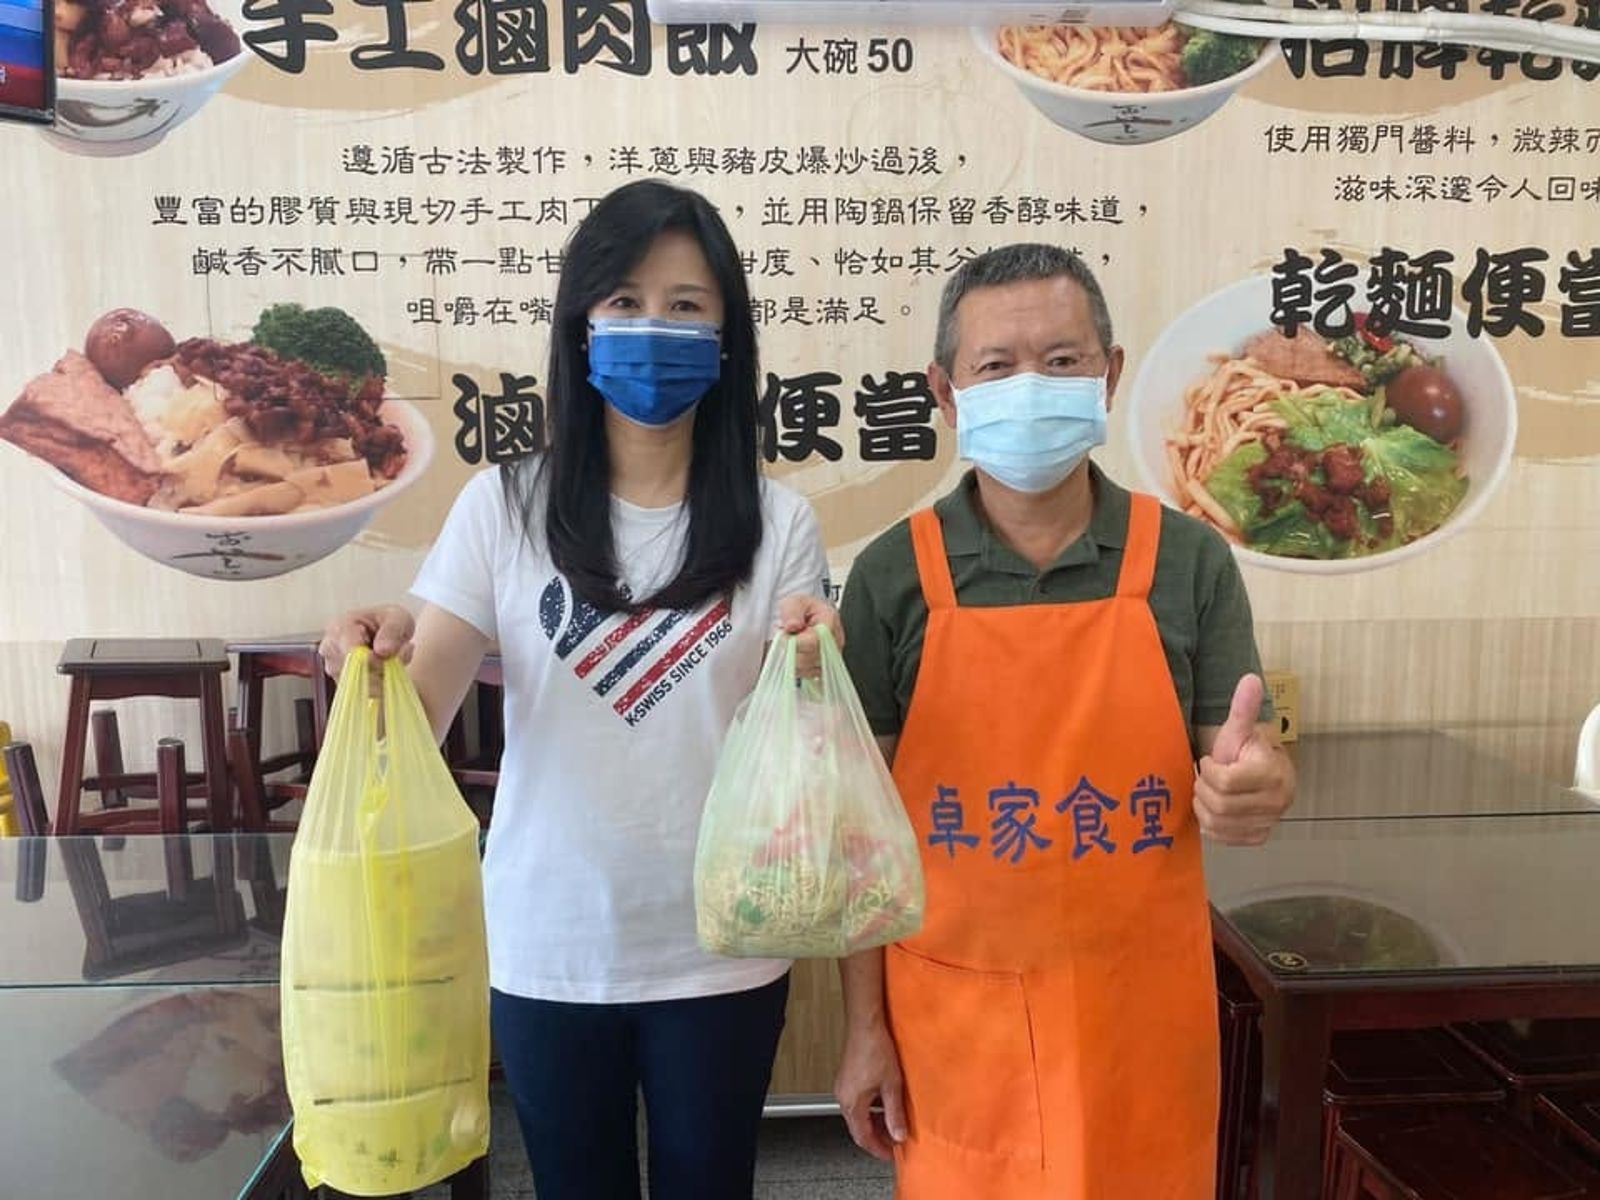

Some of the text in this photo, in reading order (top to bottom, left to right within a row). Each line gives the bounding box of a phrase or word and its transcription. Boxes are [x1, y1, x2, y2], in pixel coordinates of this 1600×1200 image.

[786, 38, 914, 75] 大碗 50
[758, 371, 938, 463] 便當
[669, 644, 708, 684] SINCE
[704, 619, 733, 649] 1966
[927, 774, 1174, 864] 卓家食堂
